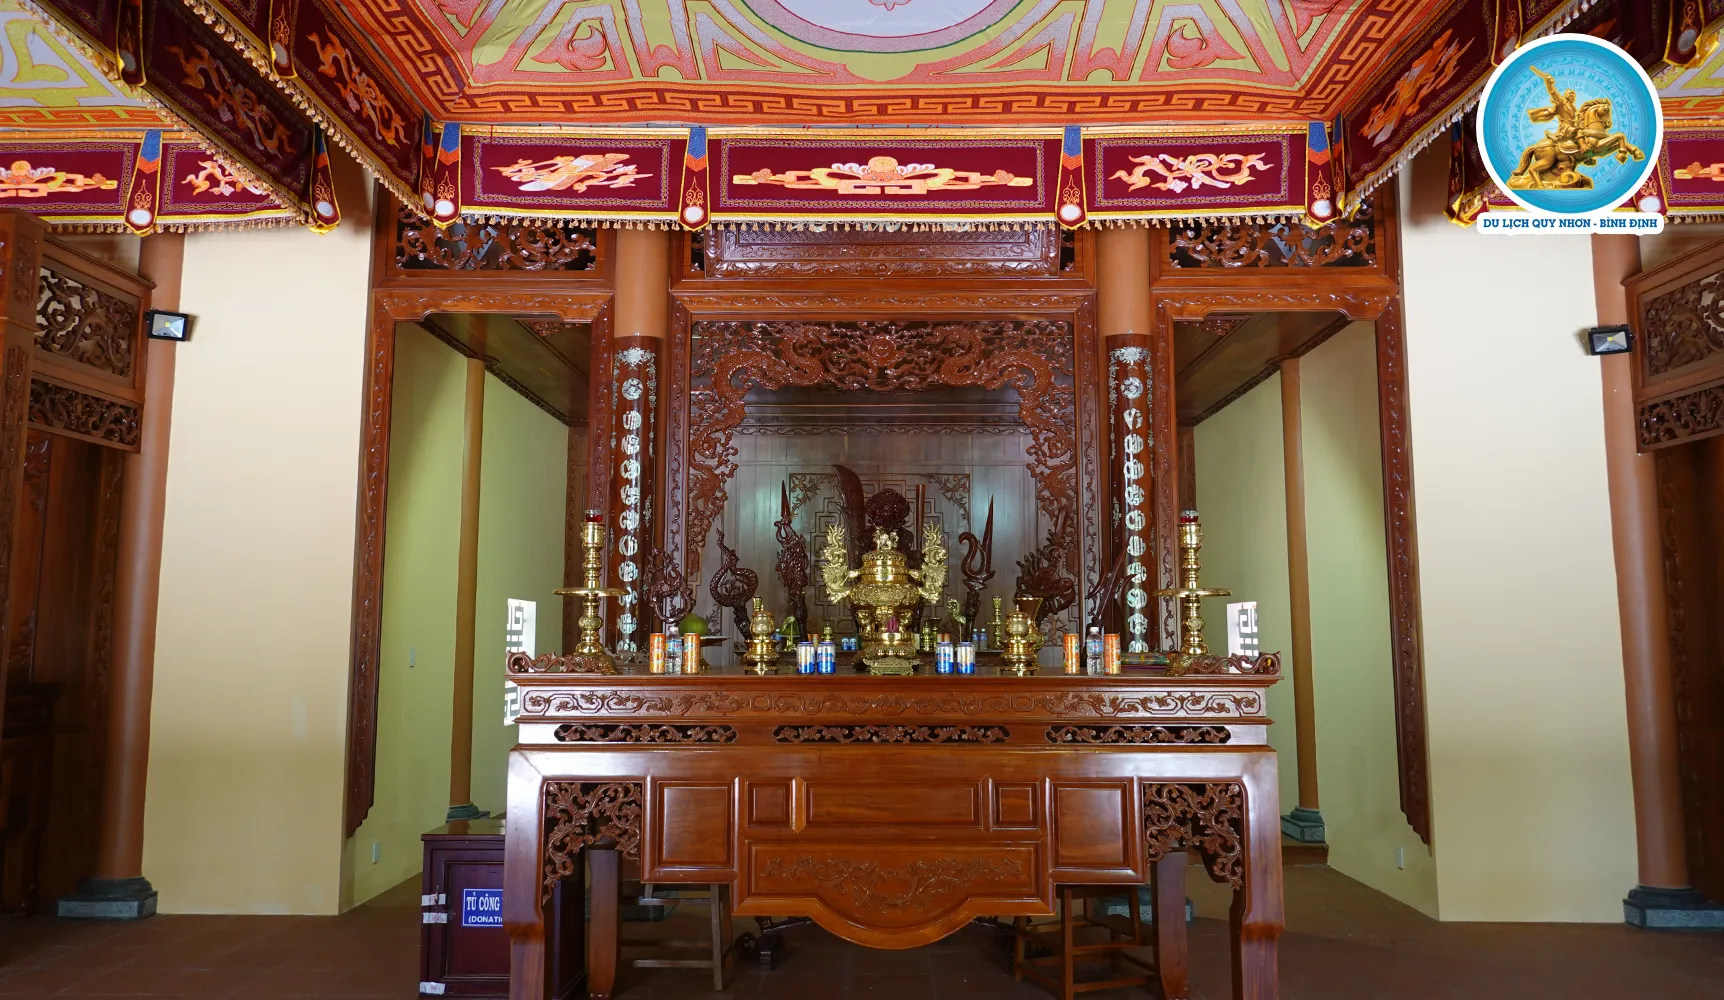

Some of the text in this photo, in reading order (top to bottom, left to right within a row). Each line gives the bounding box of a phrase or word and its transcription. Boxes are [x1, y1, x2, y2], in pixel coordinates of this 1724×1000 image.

[466, 891, 500, 911] TỦ CÔNG
[468, 915, 503, 923] (DONATI
